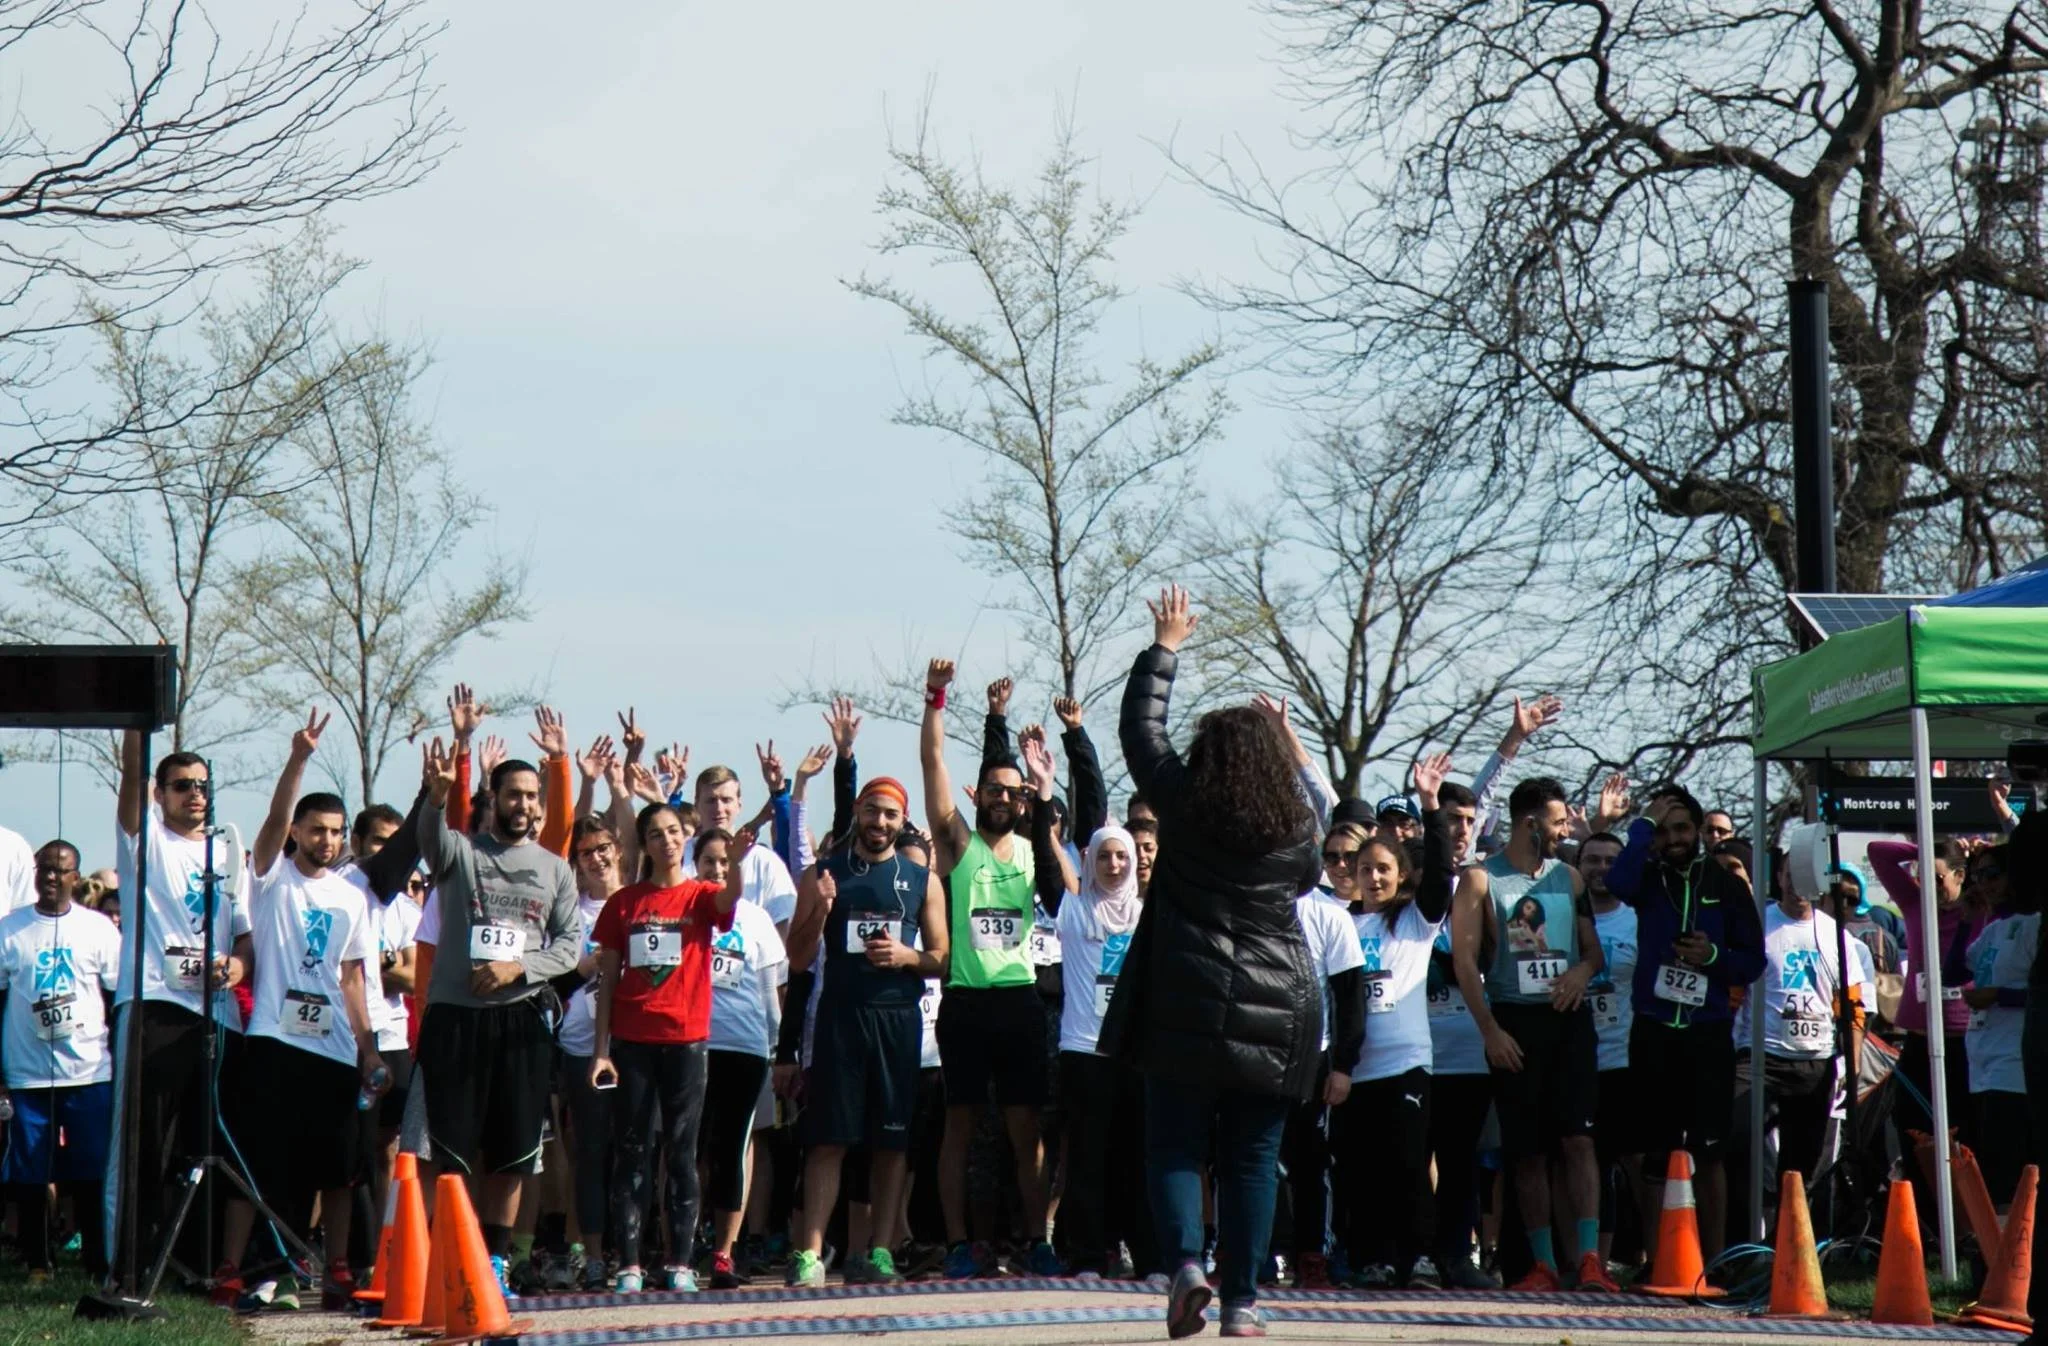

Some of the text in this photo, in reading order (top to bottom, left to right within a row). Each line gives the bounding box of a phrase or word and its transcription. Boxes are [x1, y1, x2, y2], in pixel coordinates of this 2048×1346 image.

[1843, 797, 1951, 811] Montrose Hbor
[980, 918, 1014, 936] 339
[480, 927, 516, 948] 613
[647, 934, 660, 951] 9
[713, 957, 732, 975] 01
[1527, 961, 1560, 979] 411
[1783, 949, 1820, 974] GA
[1664, 968, 1698, 992] 572
[41, 1005, 72, 1027] 807
[297, 1003, 322, 1023] 42
[1789, 1021, 1820, 1038] 305
